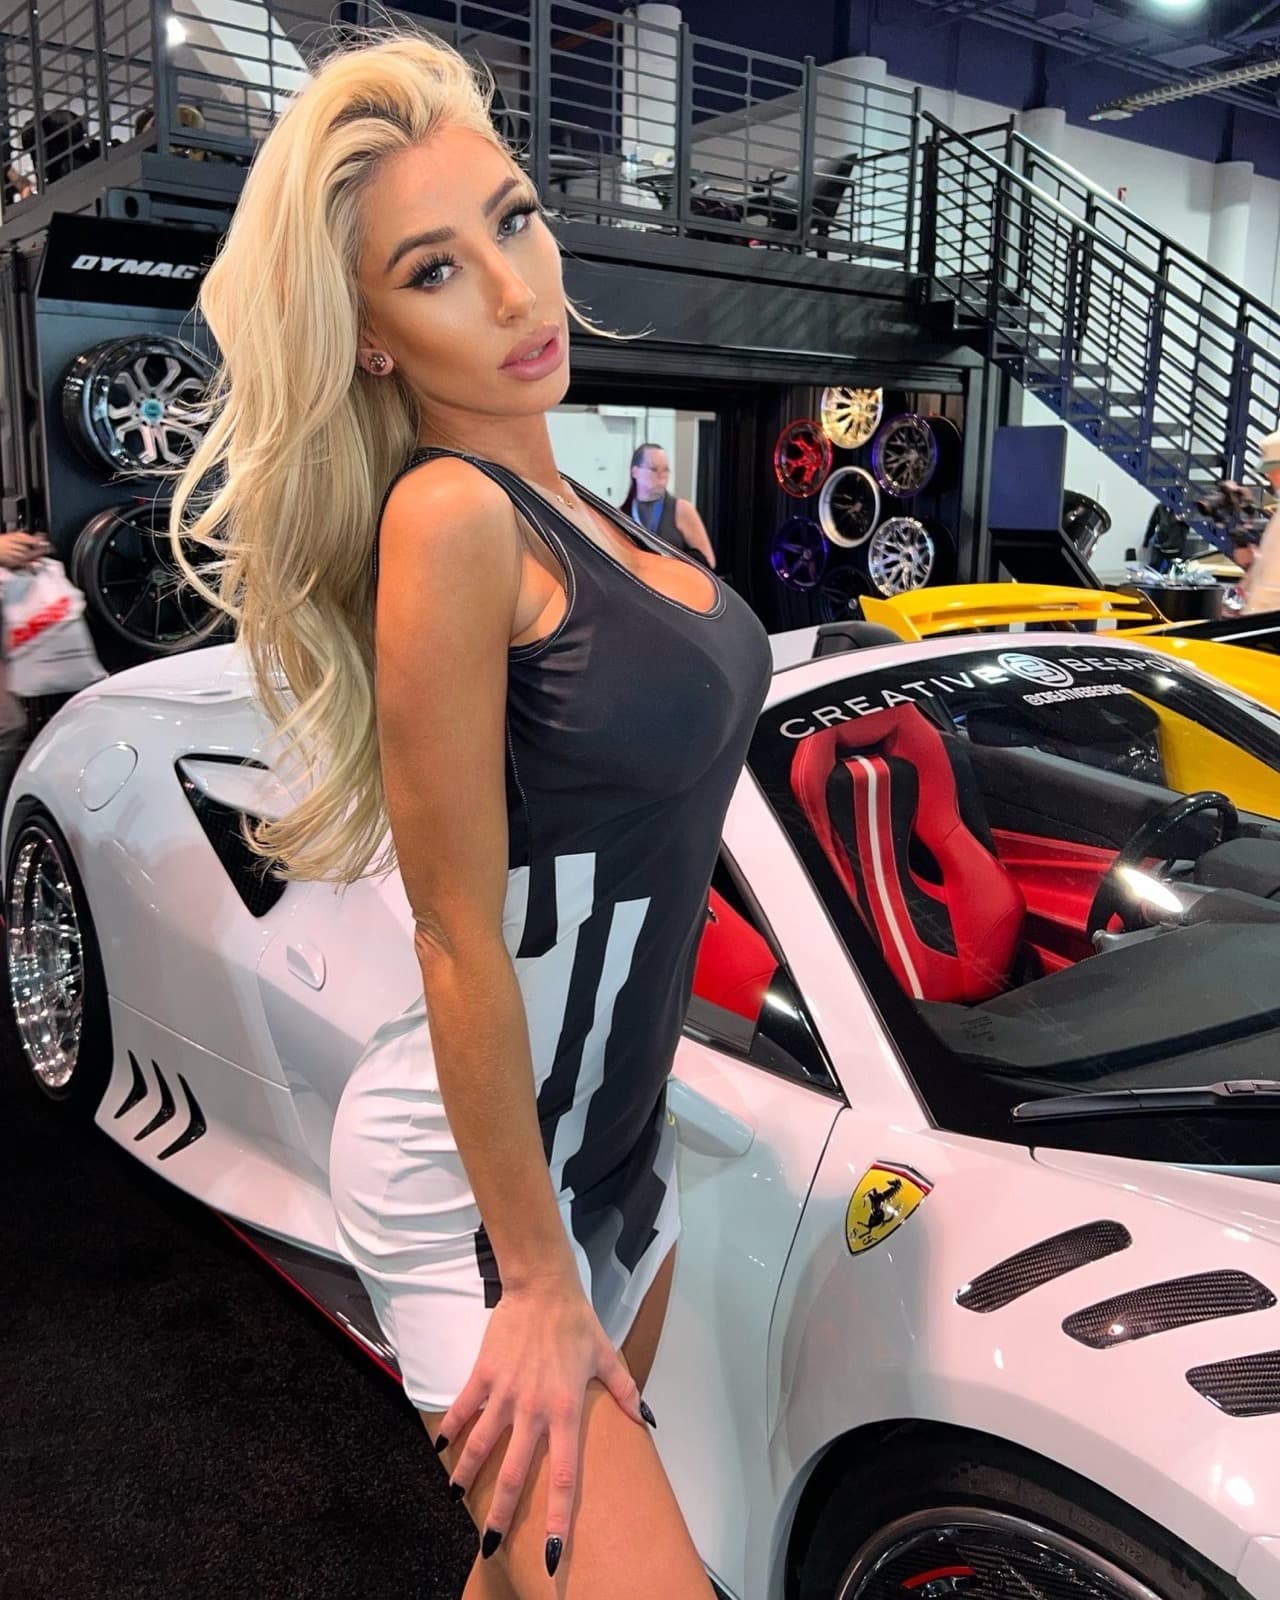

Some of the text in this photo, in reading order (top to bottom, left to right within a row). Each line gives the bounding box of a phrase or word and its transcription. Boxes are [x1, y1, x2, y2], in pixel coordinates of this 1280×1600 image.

[72, 254, 200, 280] DYMAG
[779, 666, 1010, 739] CREATIVE
[1022, 684, 1128, 706] @CREATIVEBESPO
